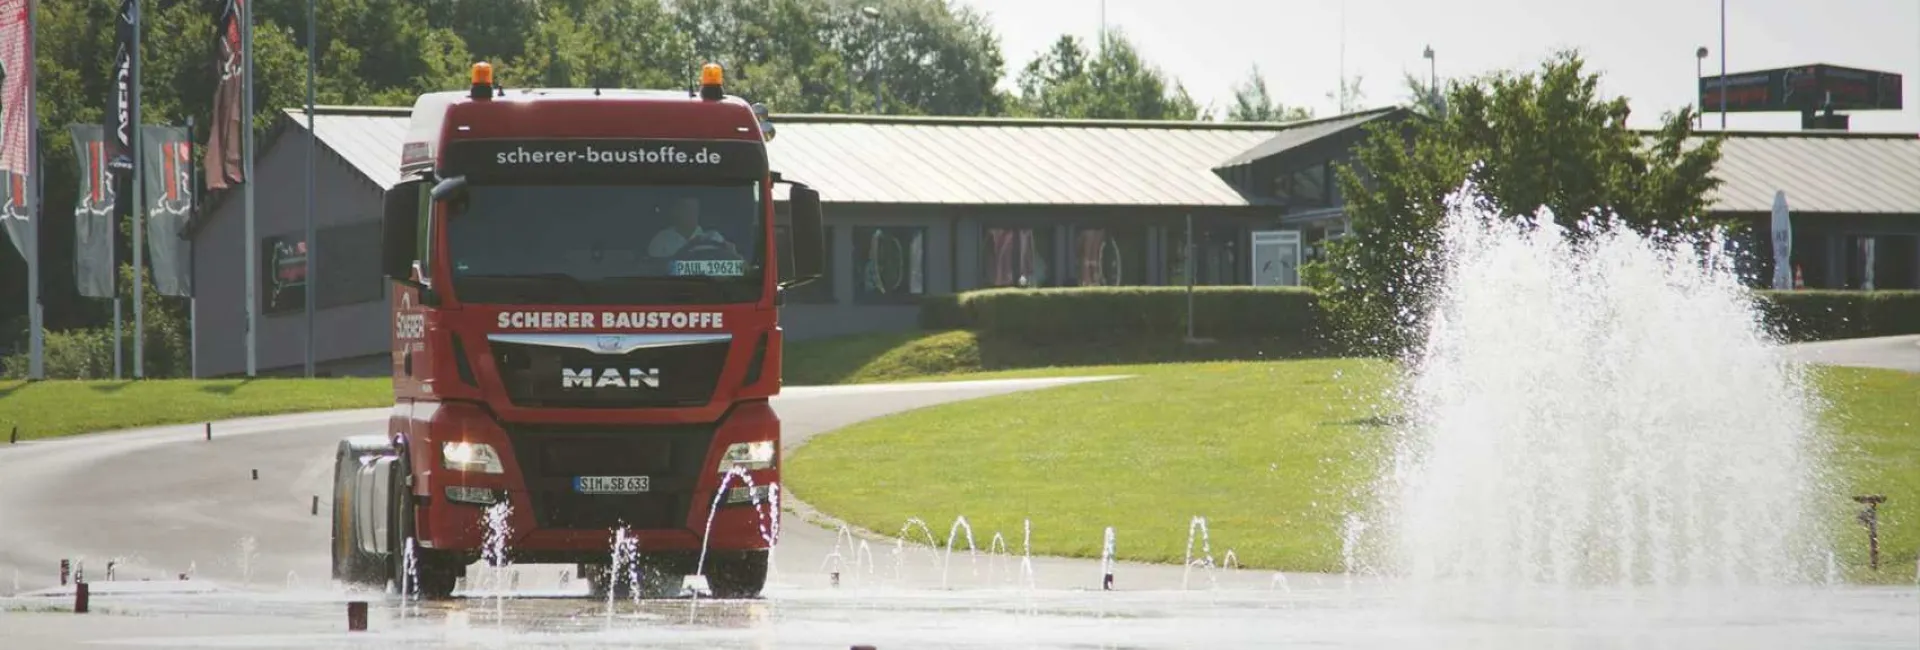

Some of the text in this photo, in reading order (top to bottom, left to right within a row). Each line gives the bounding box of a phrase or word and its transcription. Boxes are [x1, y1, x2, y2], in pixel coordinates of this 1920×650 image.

[496, 146, 722, 165] scherer-baustoffe.de
[677, 261, 702, 274] PAUL
[497, 311, 724, 329] SCHERER BAUSTOFFE
[562, 368, 660, 388] MAN
[610, 477, 625, 490] SB
[627, 477, 648, 490] 633
